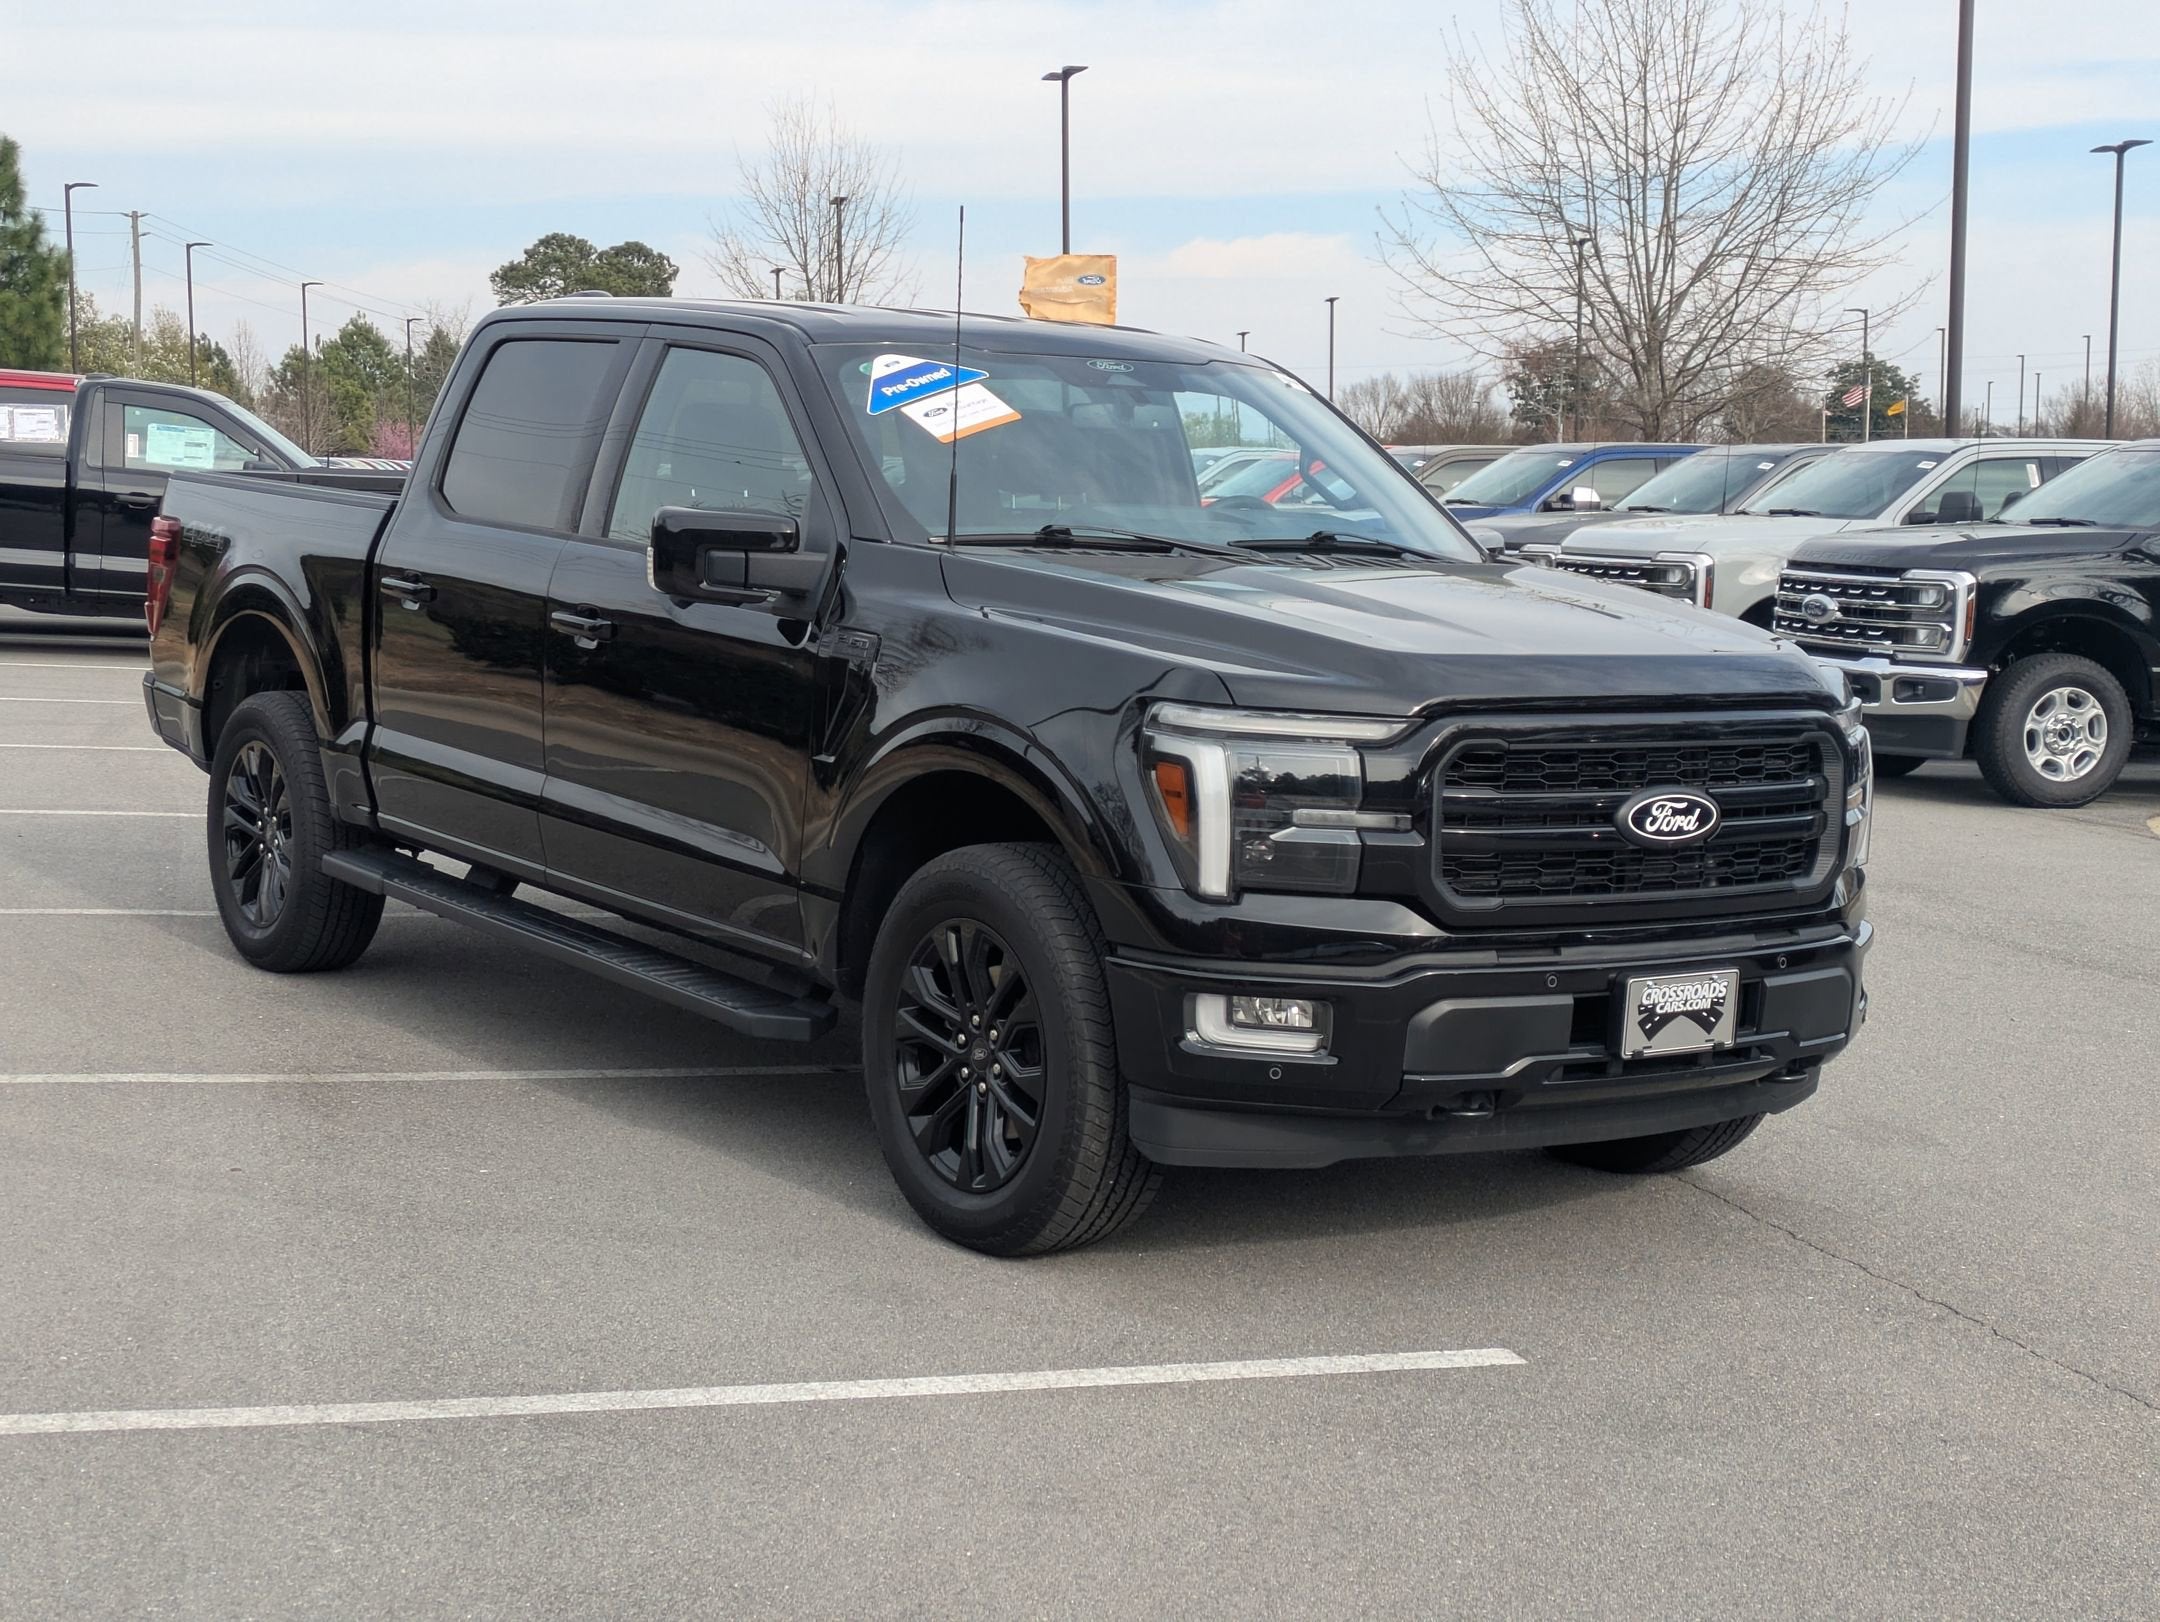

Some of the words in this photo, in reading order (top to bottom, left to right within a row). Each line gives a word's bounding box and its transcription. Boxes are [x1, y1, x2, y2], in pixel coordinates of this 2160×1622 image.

[881, 367, 952, 397] Pre-Owned
[1645, 800, 1702, 832] Ford
[1641, 980, 1729, 1005] CROSSROADS
[1655, 998, 1712, 1014] CARS.COM
